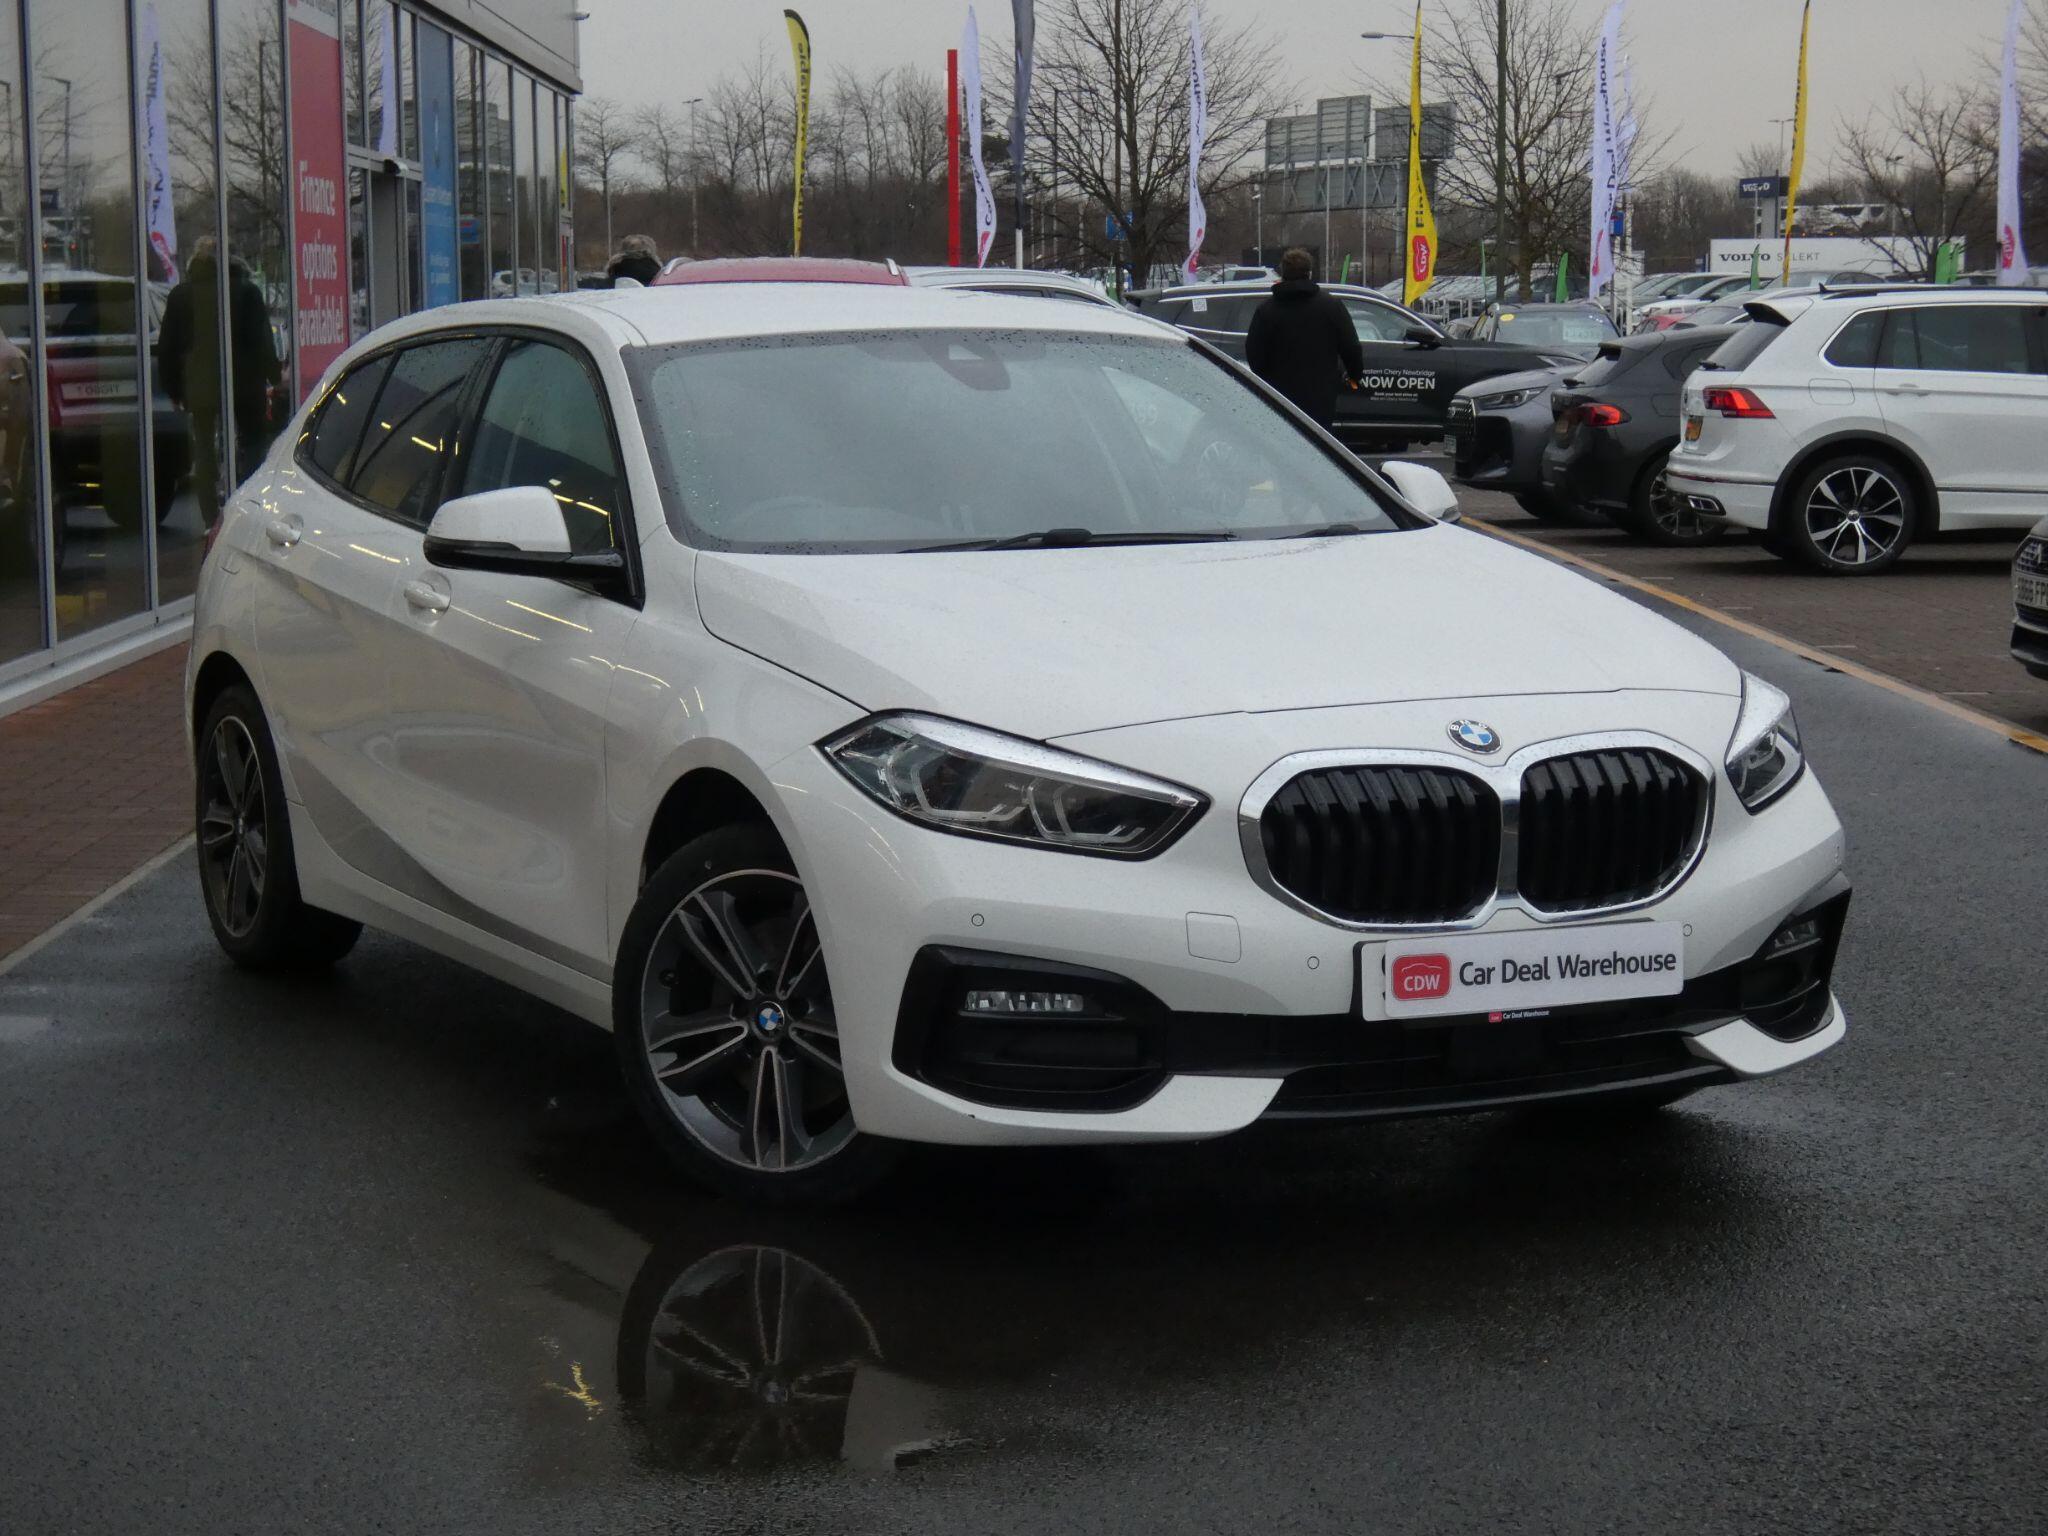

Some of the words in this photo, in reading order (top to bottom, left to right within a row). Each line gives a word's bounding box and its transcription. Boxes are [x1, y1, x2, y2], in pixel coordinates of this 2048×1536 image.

[299, 159, 336, 217] Finance
[302, 231, 337, 295] options
[1777, 252, 1820, 262] SLEKT
[298, 296, 344, 347] available!
[1359, 376, 1394, 389] NOW
[1396, 377, 1436, 390] OPEN
[1383, 369, 1401, 377] Chery
[1402, 369, 1436, 378] Newbridge
[1458, 961, 1497, 987] Car
[1501, 955, 1551, 984] Deal
[1557, 950, 1677, 979] Warehouse
[1403, 974, 1441, 992] CDW
